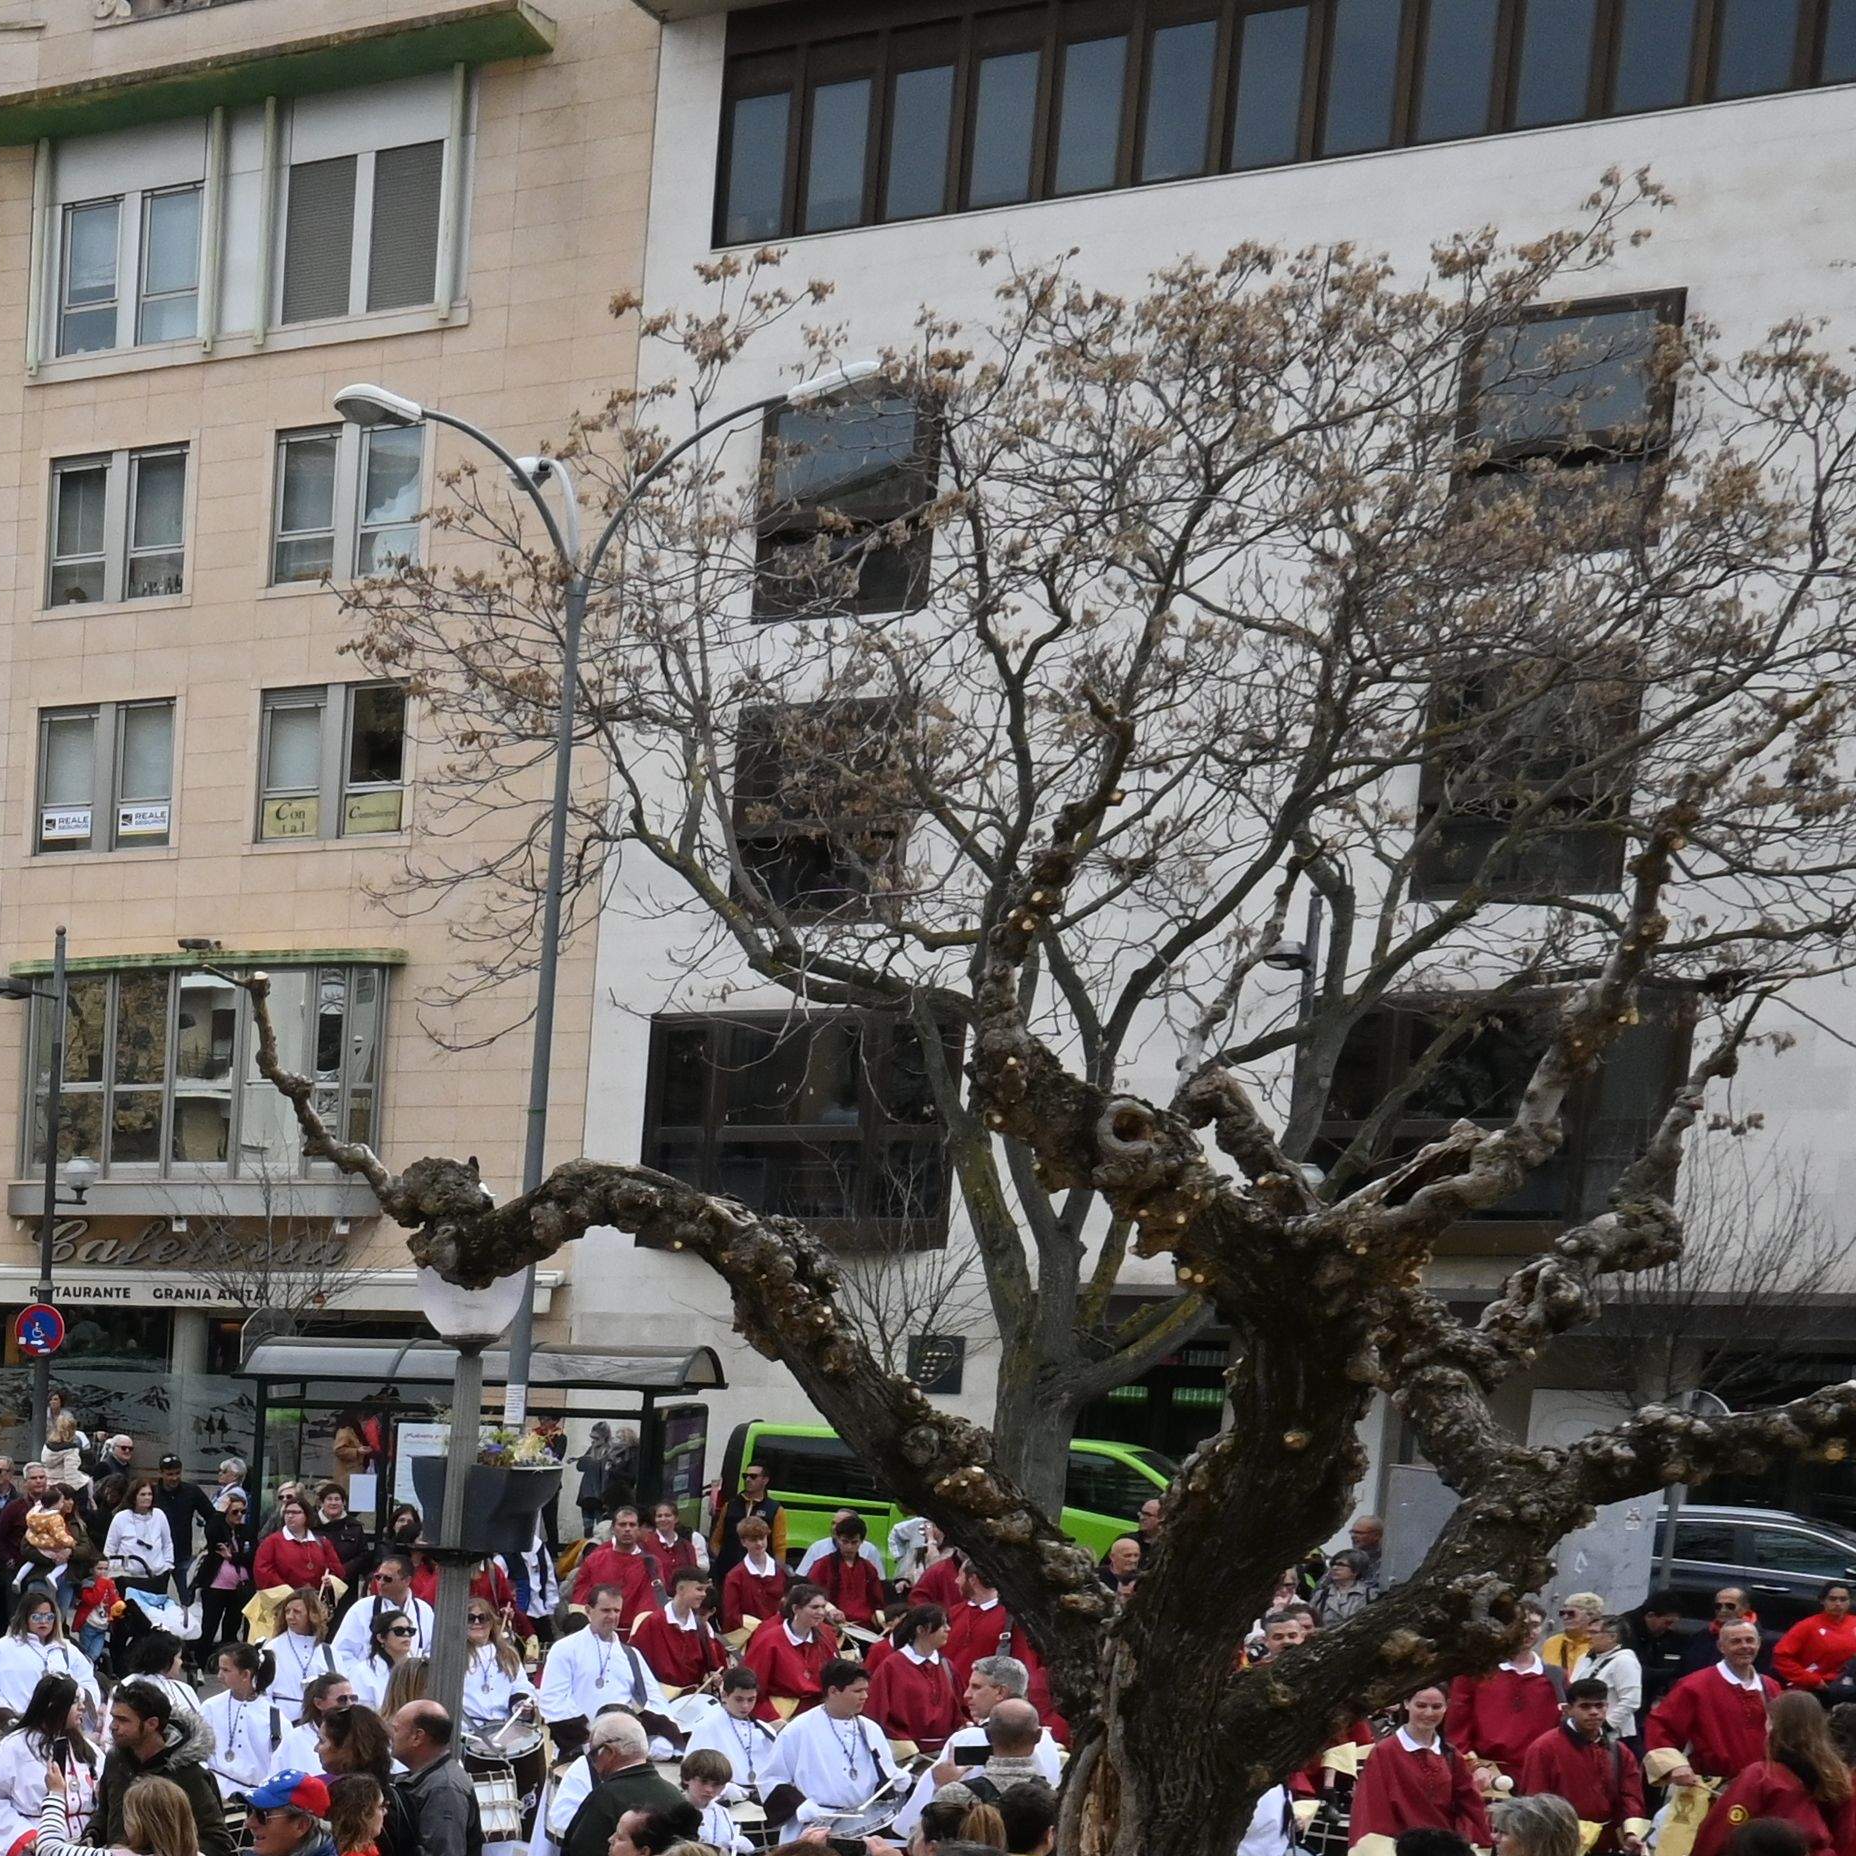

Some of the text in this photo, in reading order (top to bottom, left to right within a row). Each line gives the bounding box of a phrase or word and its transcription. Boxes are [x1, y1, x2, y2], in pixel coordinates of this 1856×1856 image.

[135, 811, 166, 820] REALE
[58, 816, 89, 825] REALE
[29, 1285, 131, 1299] RTAURANTE
[153, 1287, 212, 1301] GRANJA
